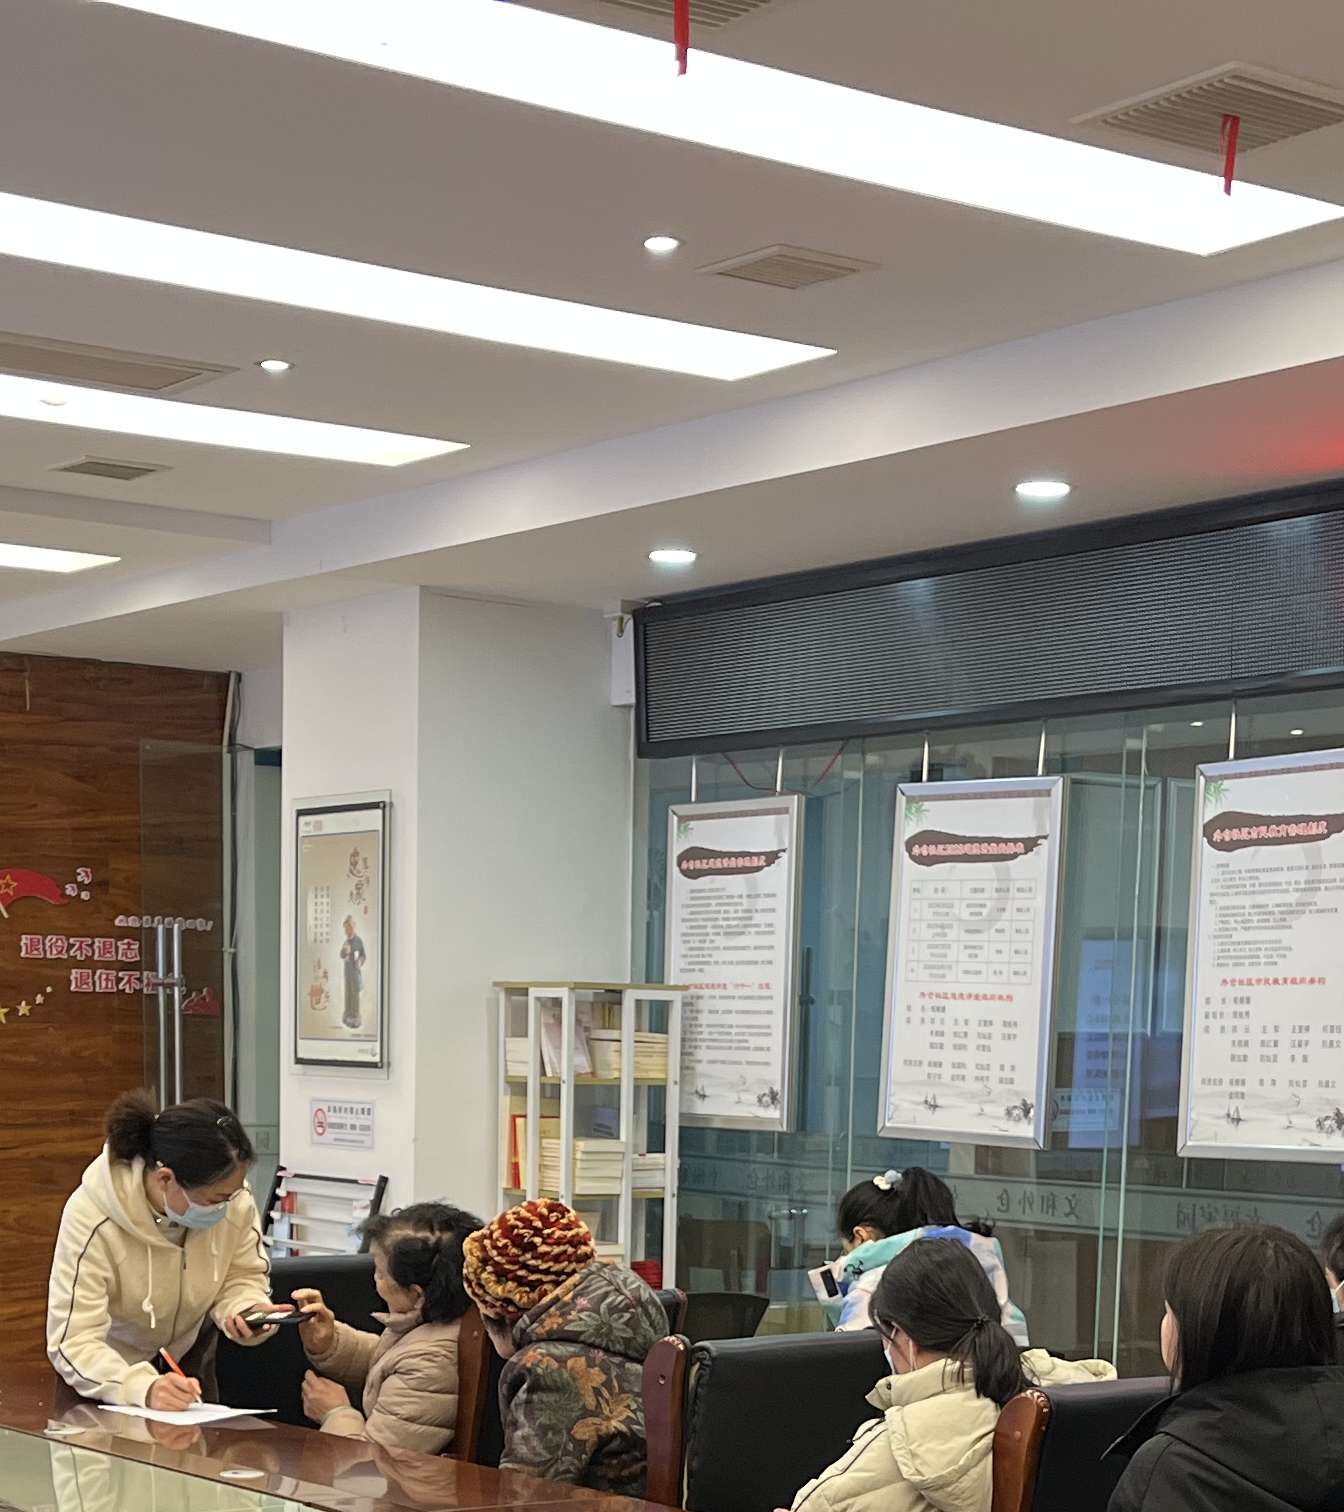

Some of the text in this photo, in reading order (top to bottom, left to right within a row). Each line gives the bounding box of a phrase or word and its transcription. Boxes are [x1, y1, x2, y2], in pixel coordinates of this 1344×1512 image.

[21, 935, 141, 962] 退役不退志
